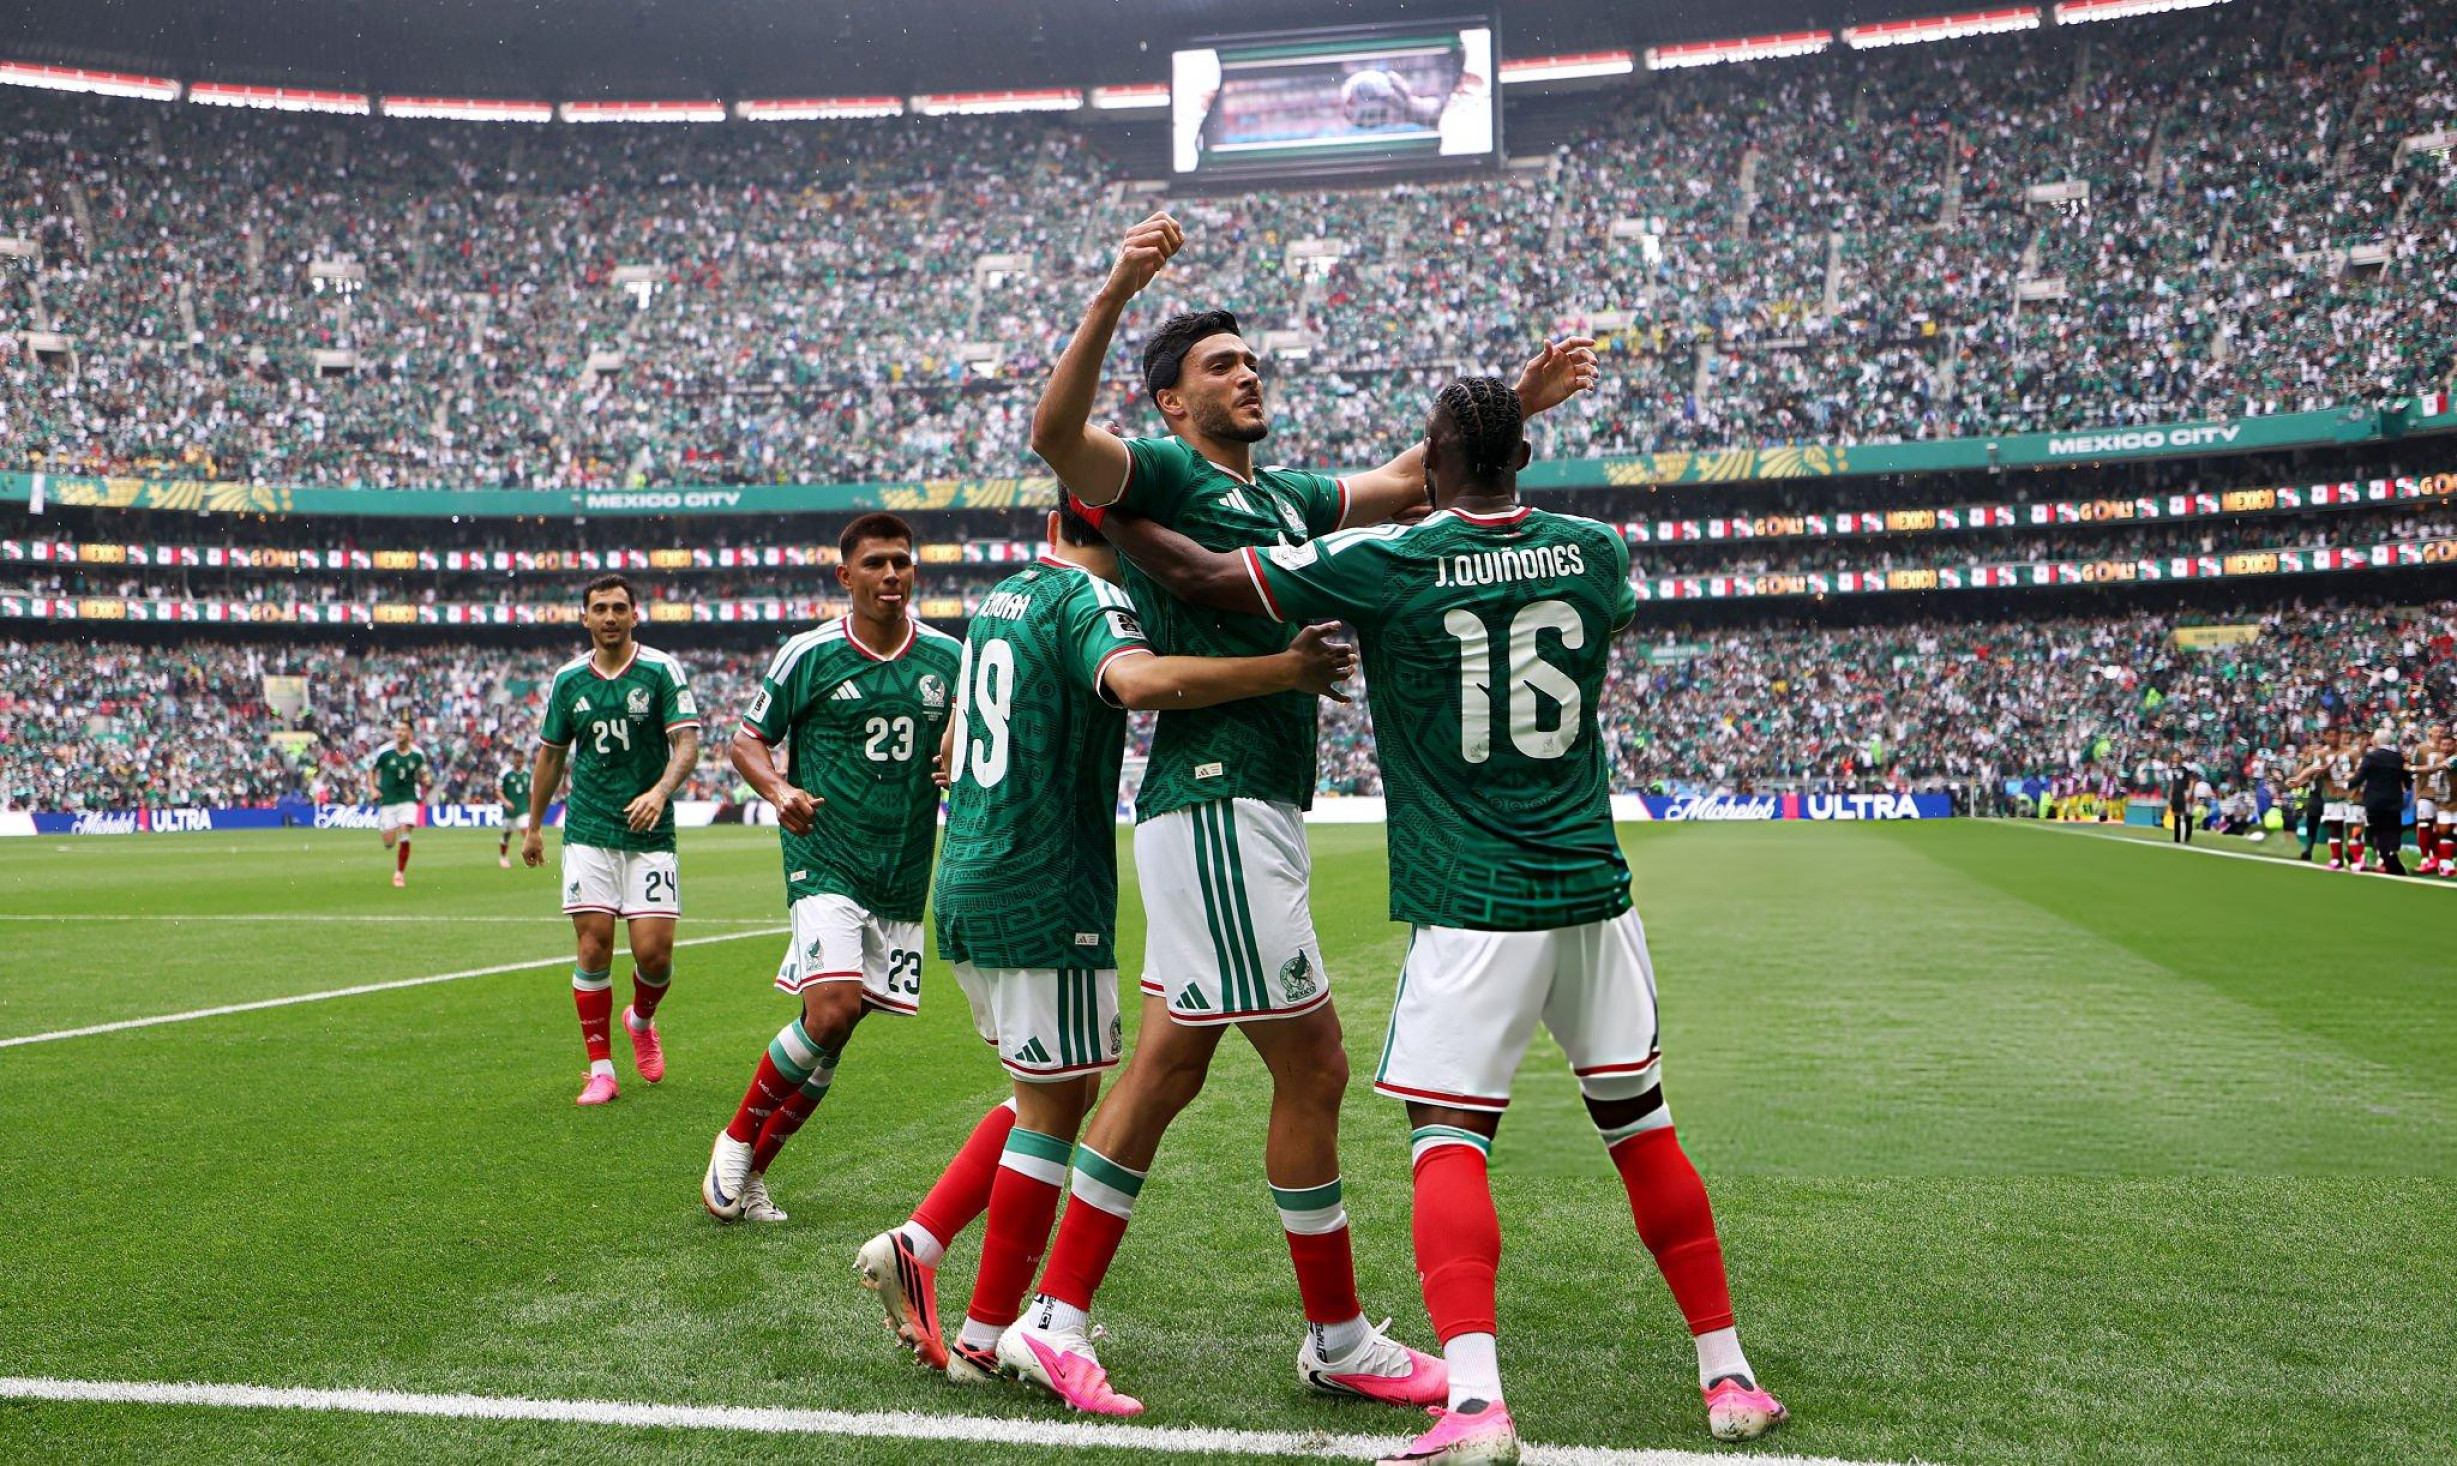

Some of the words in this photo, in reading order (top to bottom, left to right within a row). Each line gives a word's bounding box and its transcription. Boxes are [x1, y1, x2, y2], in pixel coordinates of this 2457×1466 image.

[2048, 431, 2165, 455] MEXICO
[2170, 425, 2241, 446] CITY
[587, 492, 681, 509] MEXICO
[684, 491, 741, 508] CITY
[1886, 510, 1936, 531] MEXICO
[1435, 544, 1585, 588] J.QUIÑONES
[1886, 569, 1937, 590] MEXICO
[1444, 600, 1585, 764] 16
[951, 637, 1015, 788] 19
[593, 718, 630, 754] 24
[865, 715, 914, 761] 23
[151, 808, 212, 832] ULTRA
[432, 804, 503, 827] ULTR
[1665, 793, 1776, 820] Michelob
[1808, 795, 1920, 819] ULTRA
[645, 871, 676, 902] 24
[888, 949, 922, 994] 23
